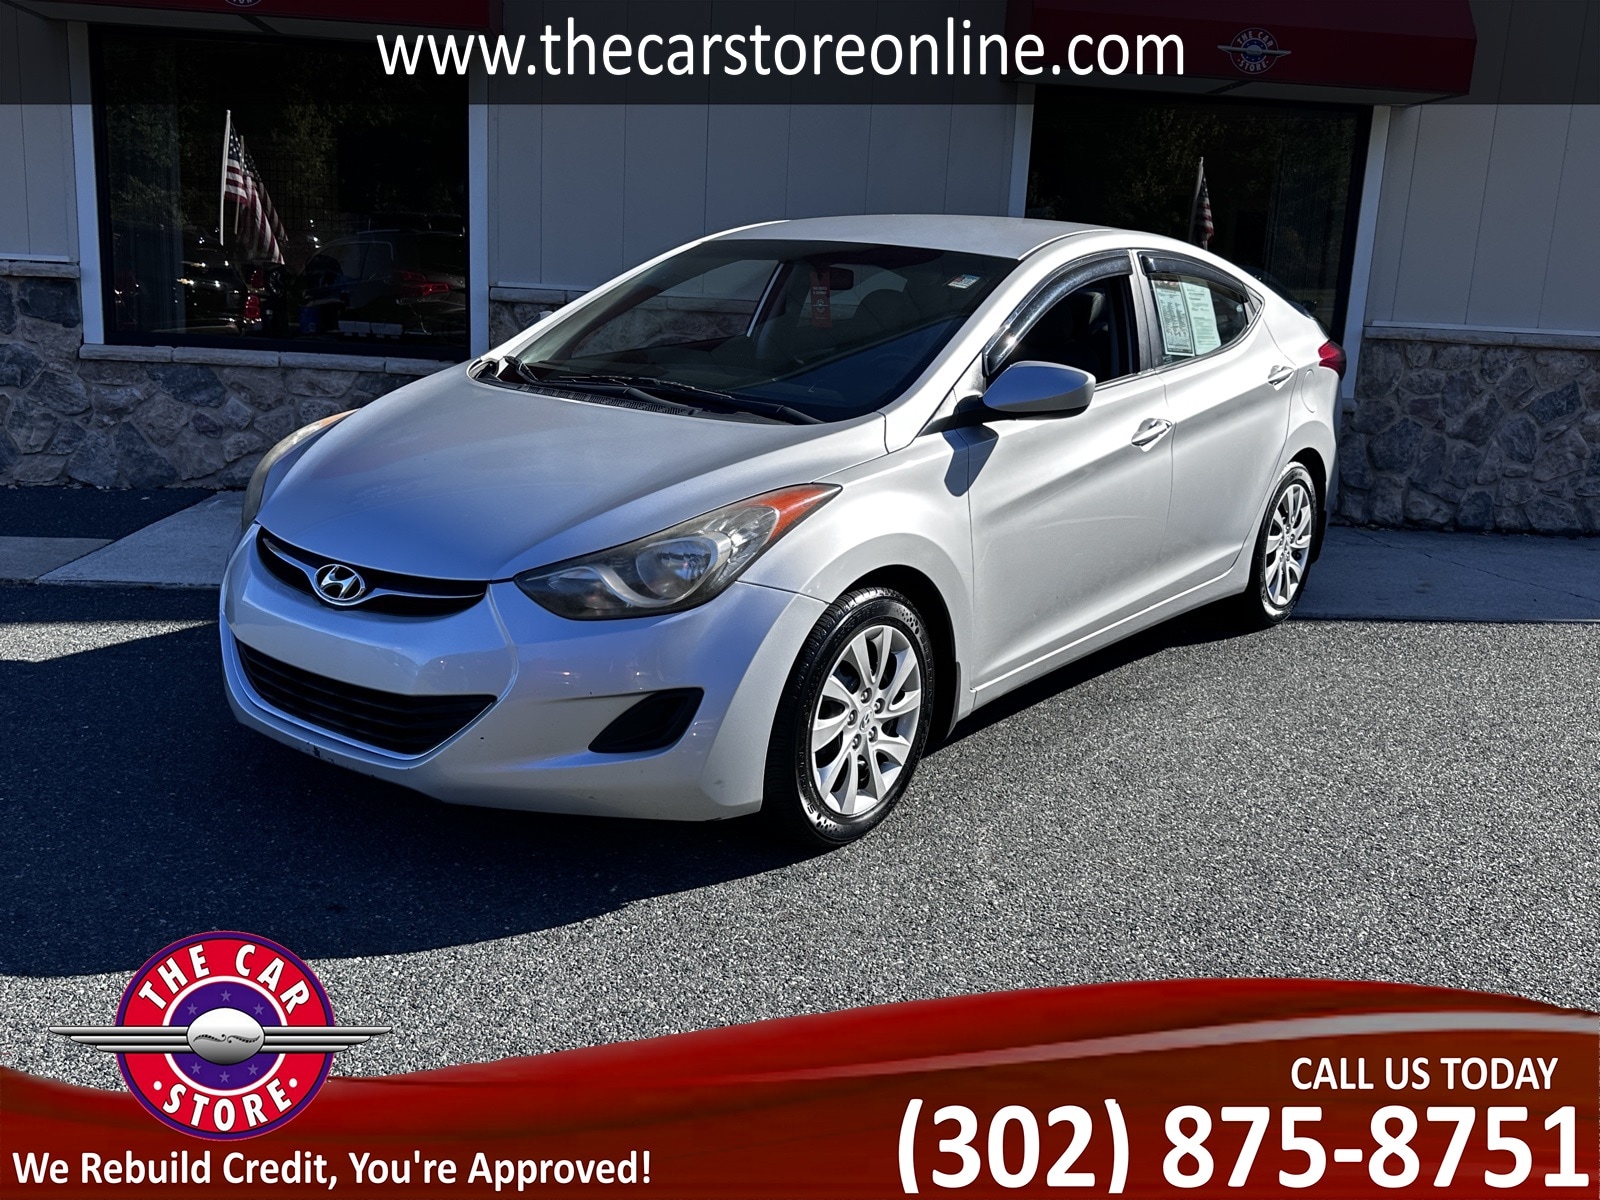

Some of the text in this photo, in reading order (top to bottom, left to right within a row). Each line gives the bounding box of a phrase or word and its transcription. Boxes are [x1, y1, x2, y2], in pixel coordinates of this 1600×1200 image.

[1236, 30, 1274, 48] THE CAR
[1238, 60, 1267, 72] STORE
